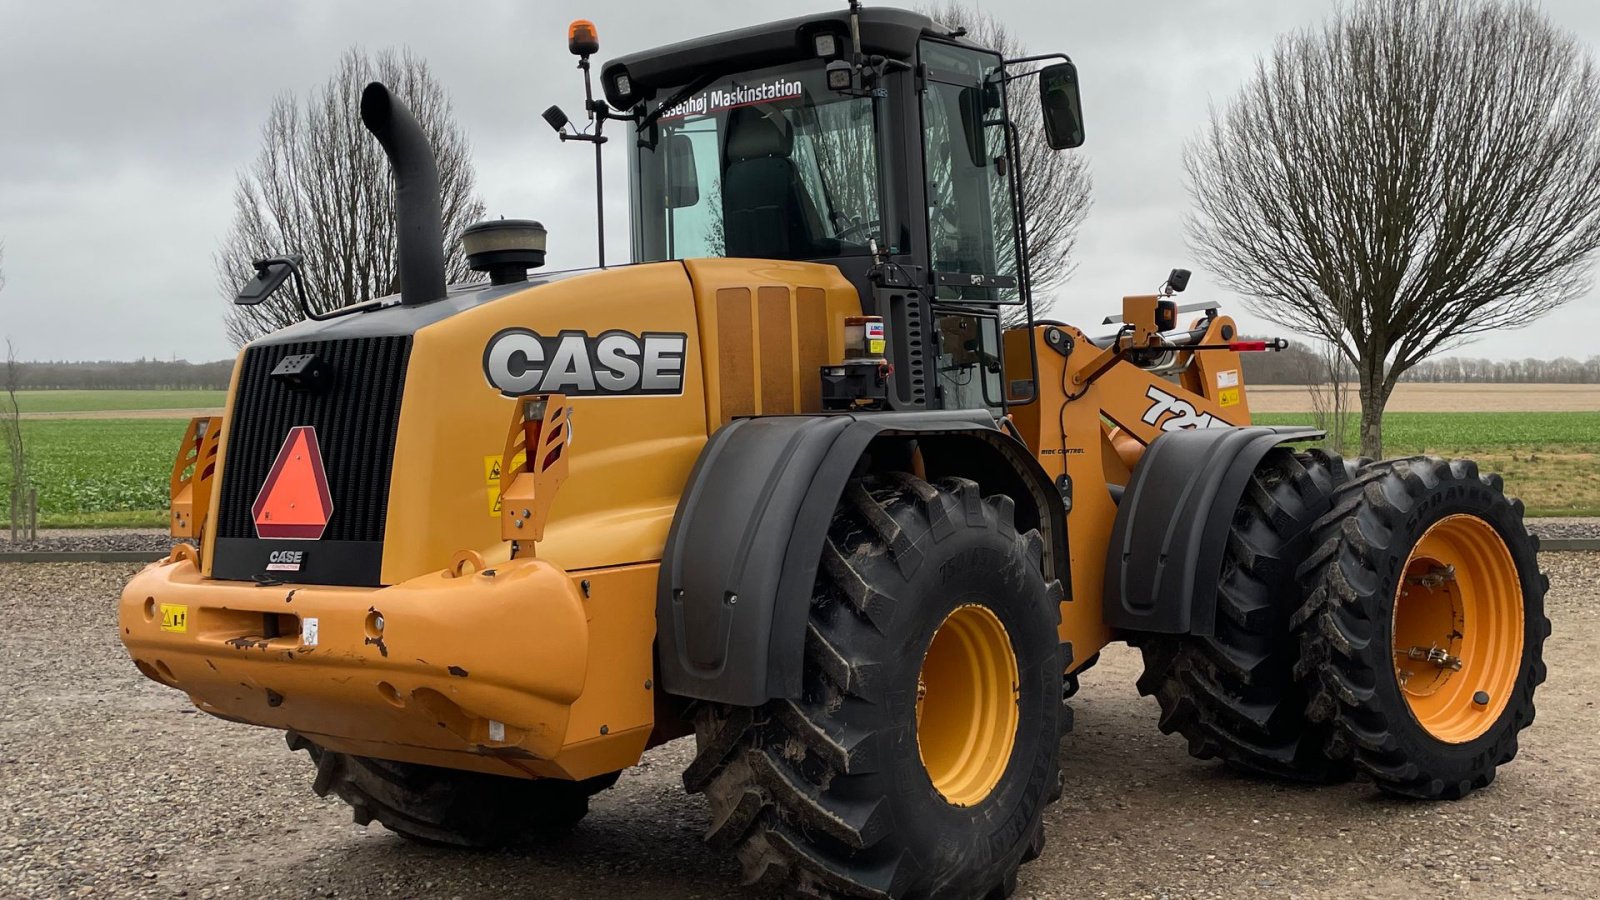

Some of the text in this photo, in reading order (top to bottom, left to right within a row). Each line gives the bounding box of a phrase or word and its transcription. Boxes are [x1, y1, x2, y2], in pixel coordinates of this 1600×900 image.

[711, 78, 802, 109] Maskinstation
[487, 333, 685, 394] CASE
[269, 550, 303, 563] CASE
